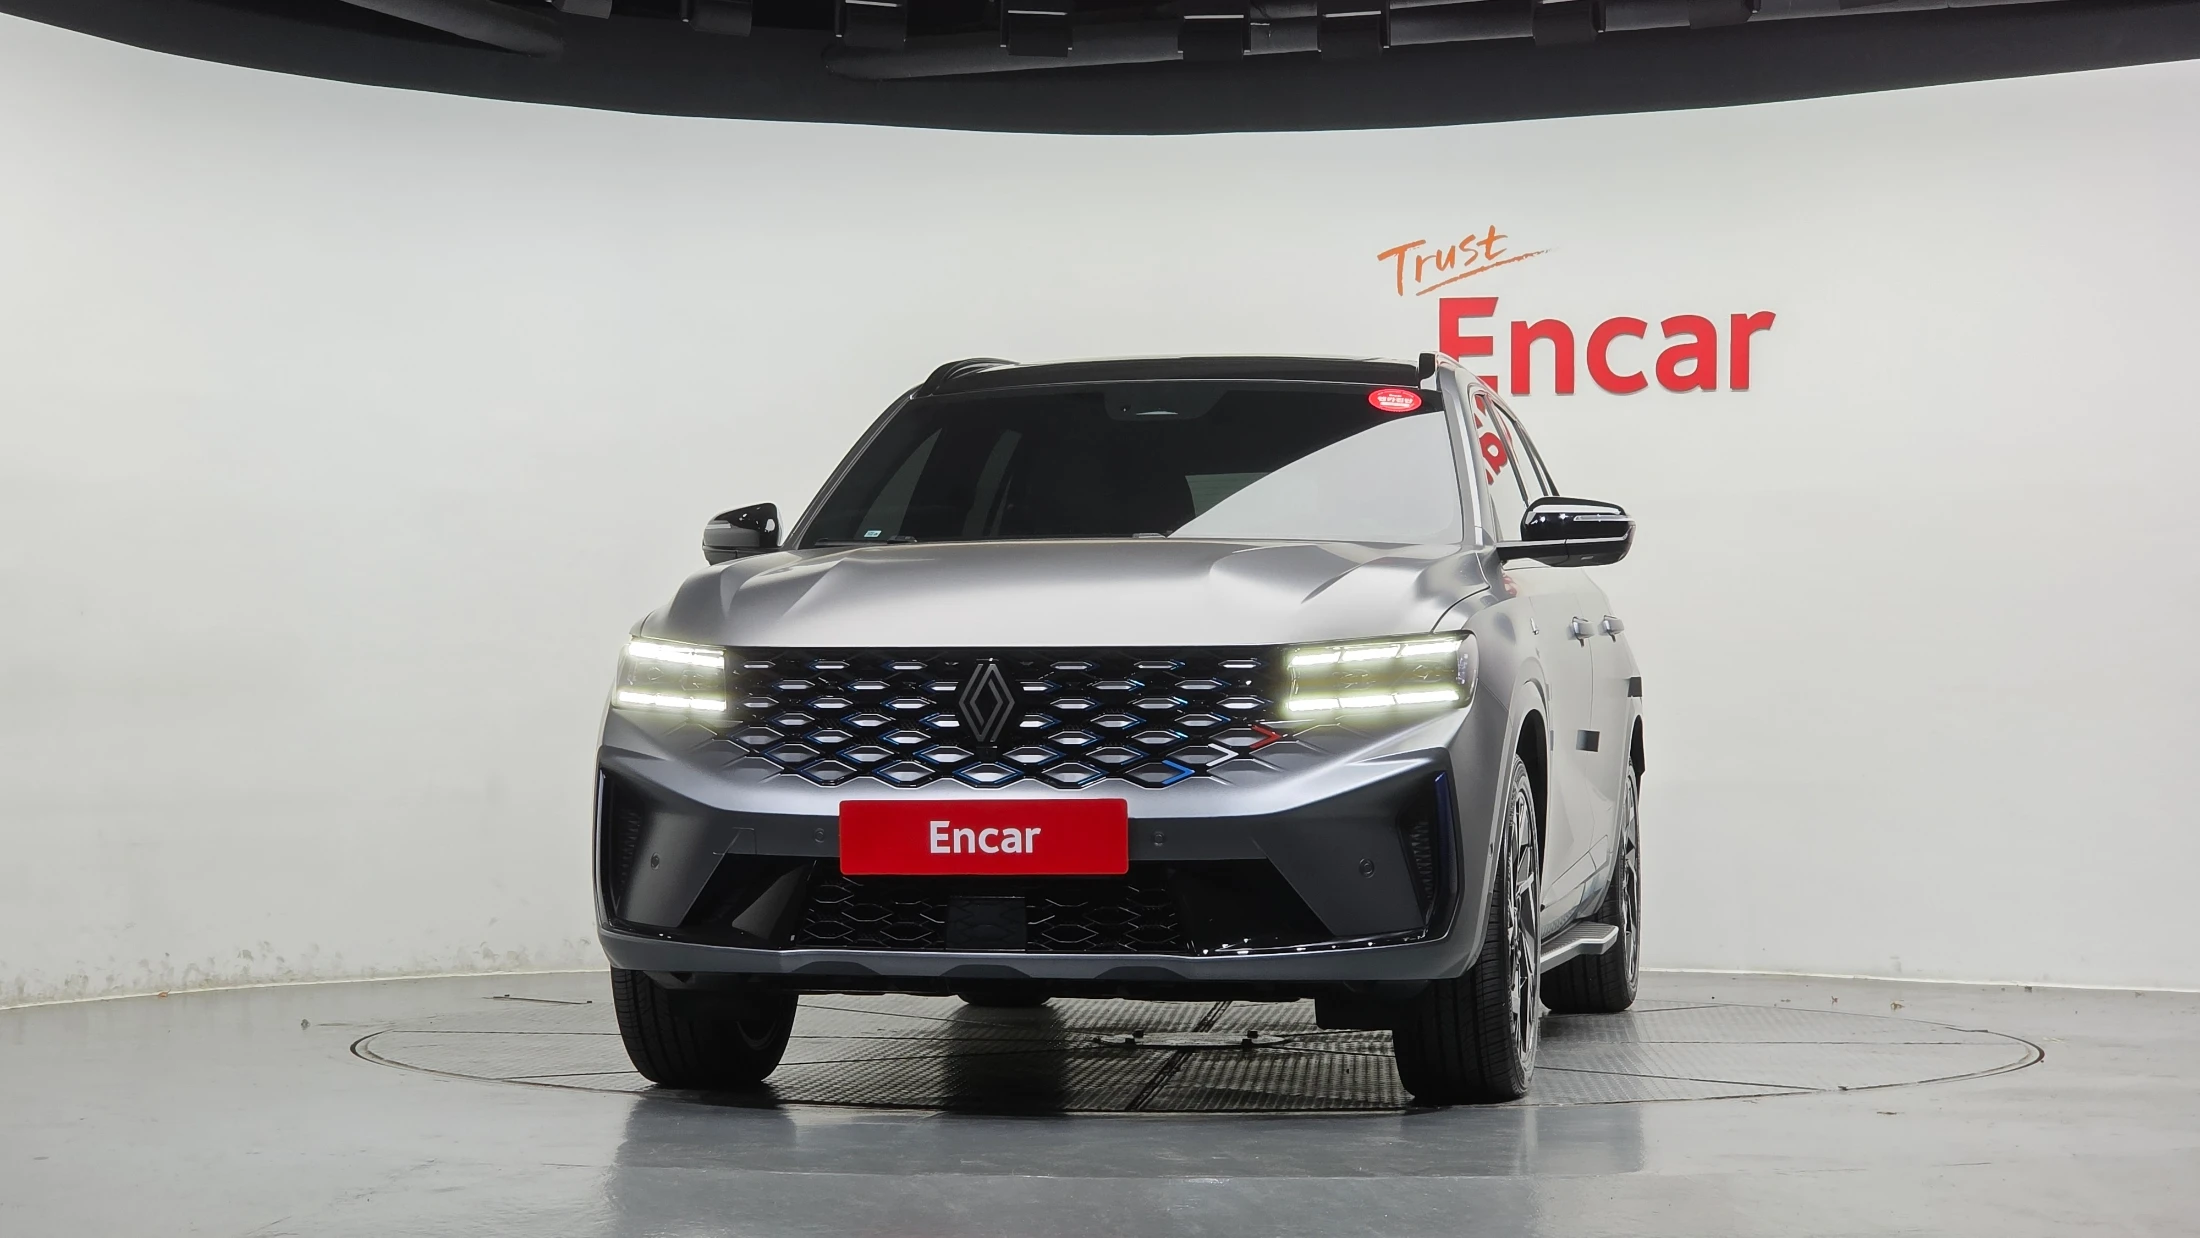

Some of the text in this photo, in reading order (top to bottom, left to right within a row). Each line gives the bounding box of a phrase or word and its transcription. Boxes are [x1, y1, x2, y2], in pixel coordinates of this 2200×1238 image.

[1377, 225, 1508, 296] Trust
[1439, 296, 1777, 395] Encar
[930, 820, 1041, 854] Encar
